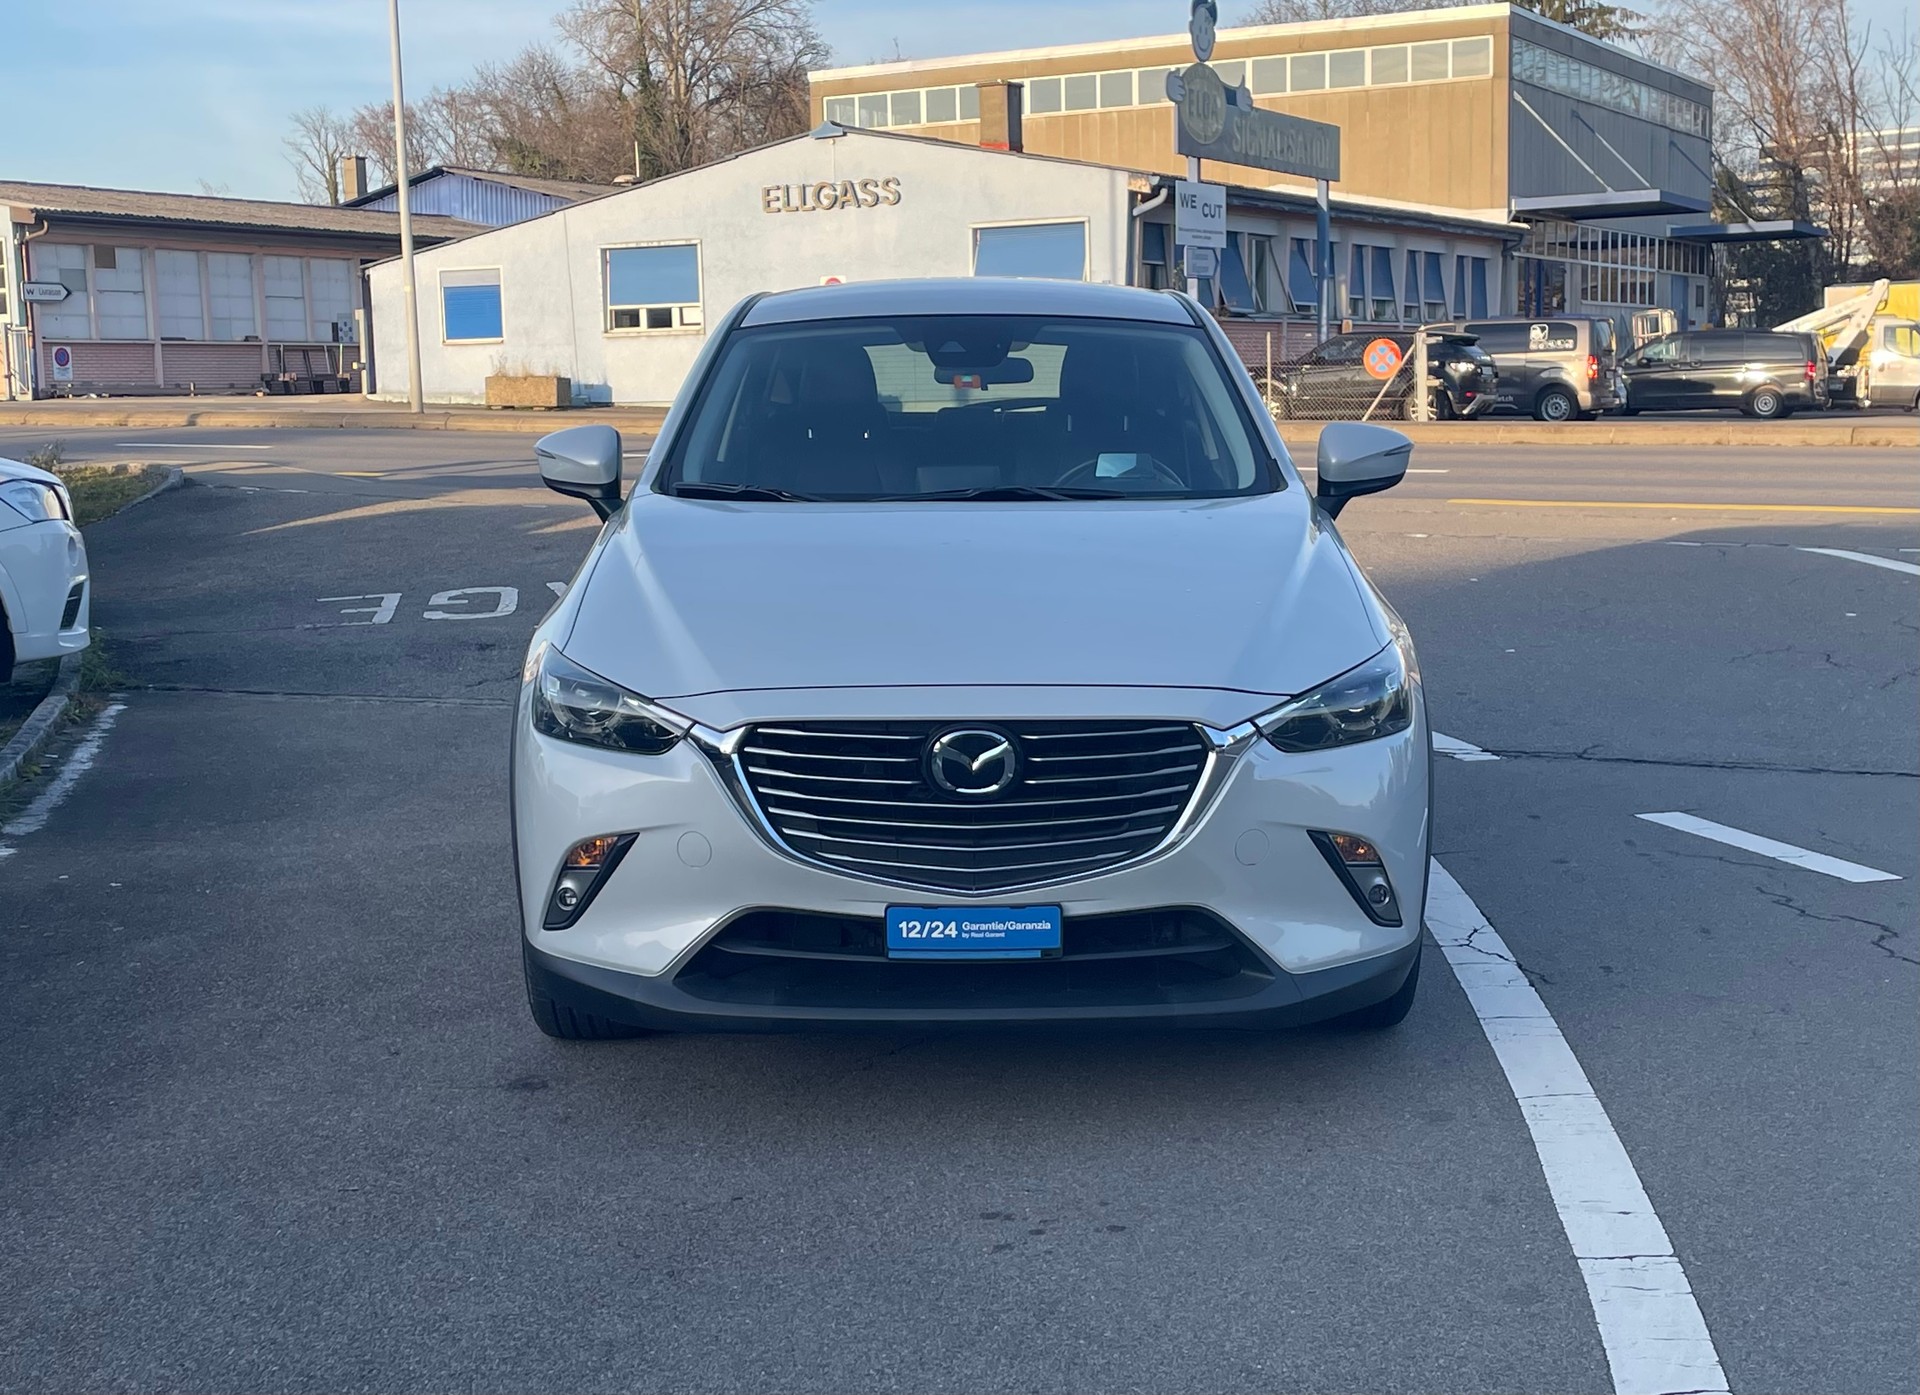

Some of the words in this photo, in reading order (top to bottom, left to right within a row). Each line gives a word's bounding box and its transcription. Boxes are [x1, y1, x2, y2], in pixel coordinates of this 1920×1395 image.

[1232, 115, 1335, 170] SIGNALISATION
[762, 176, 902, 213] ELLGASS
[1179, 192, 1198, 209] WE
[1201, 202, 1223, 219] CUT
[898, 920, 958, 939] 12/24
[962, 920, 1051, 932] Garantie/Garanzia
